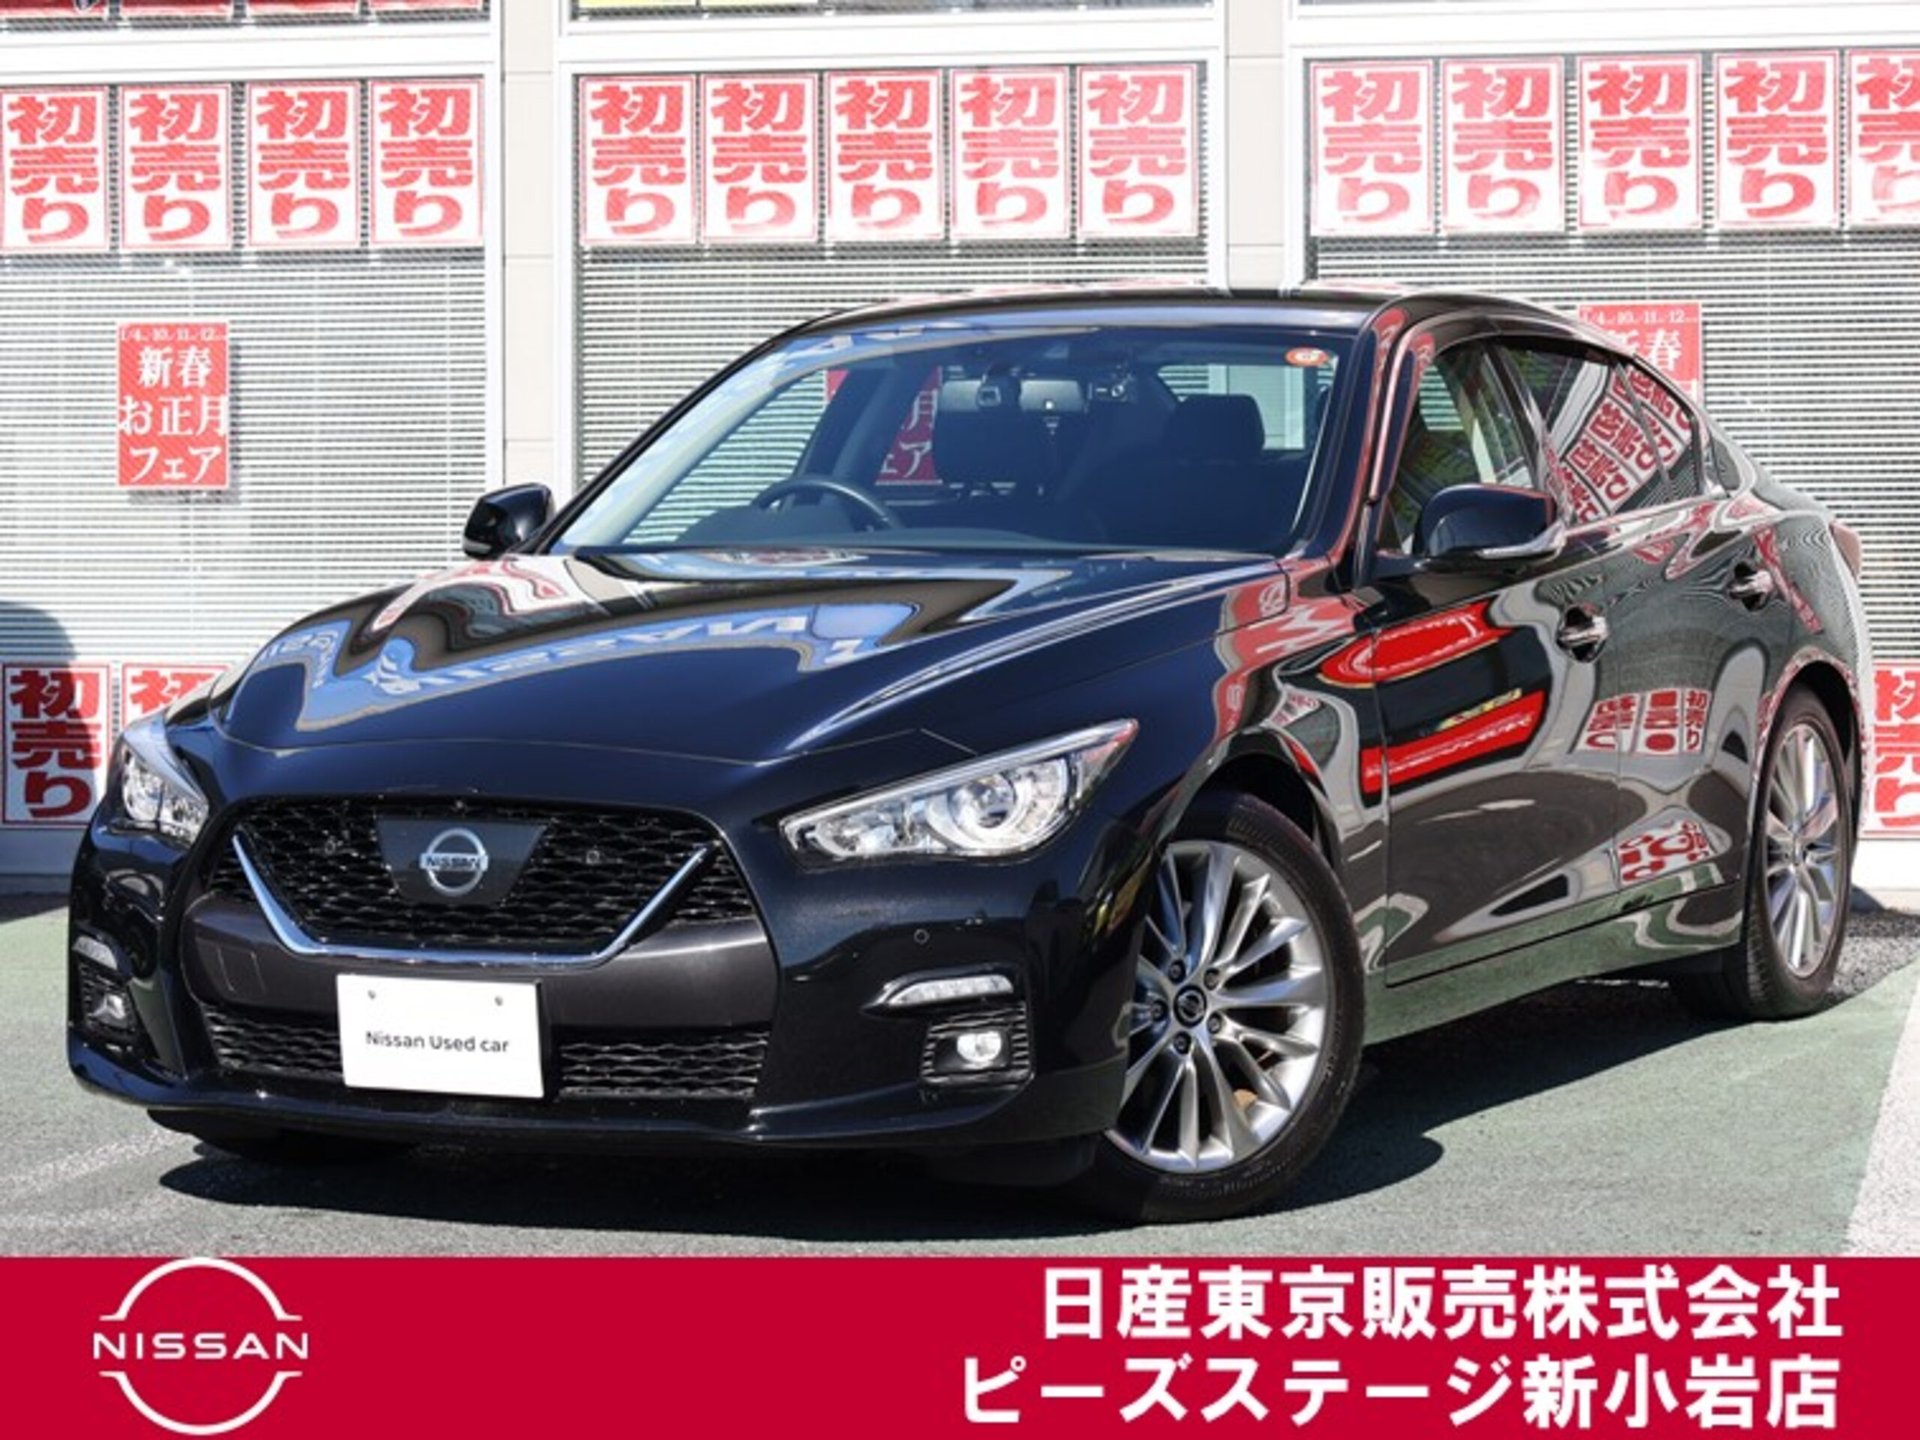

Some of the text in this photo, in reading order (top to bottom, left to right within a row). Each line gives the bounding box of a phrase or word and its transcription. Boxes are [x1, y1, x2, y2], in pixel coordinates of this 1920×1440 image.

[8, 96, 98, 243] 初売り
[129, 93, 220, 242] 初売り
[256, 90, 350, 239] 初売り
[379, 88, 473, 236] 初売り
[589, 85, 686, 234] 初売り
[712, 82, 807, 231] 初売り
[834, 80, 933, 229] 初売り
[961, 76, 1059, 225] 初売り
[1086, 74, 1186, 224] 初売り
[1322, 71, 1421, 223] 初売り
[1452, 68, 1552, 219] 初売り
[1587, 65, 1691, 217] 初売り
[1724, 62, 1827, 217] 初売り
[119, 394, 227, 437] お正月
[138, 345, 212, 388] 新春
[129, 446, 222, 483] フェア
[10, 670, 101, 818] 初売り
[425, 856, 482, 871] NISSAN
[365, 1030, 509, 1053] Nissan Used car
